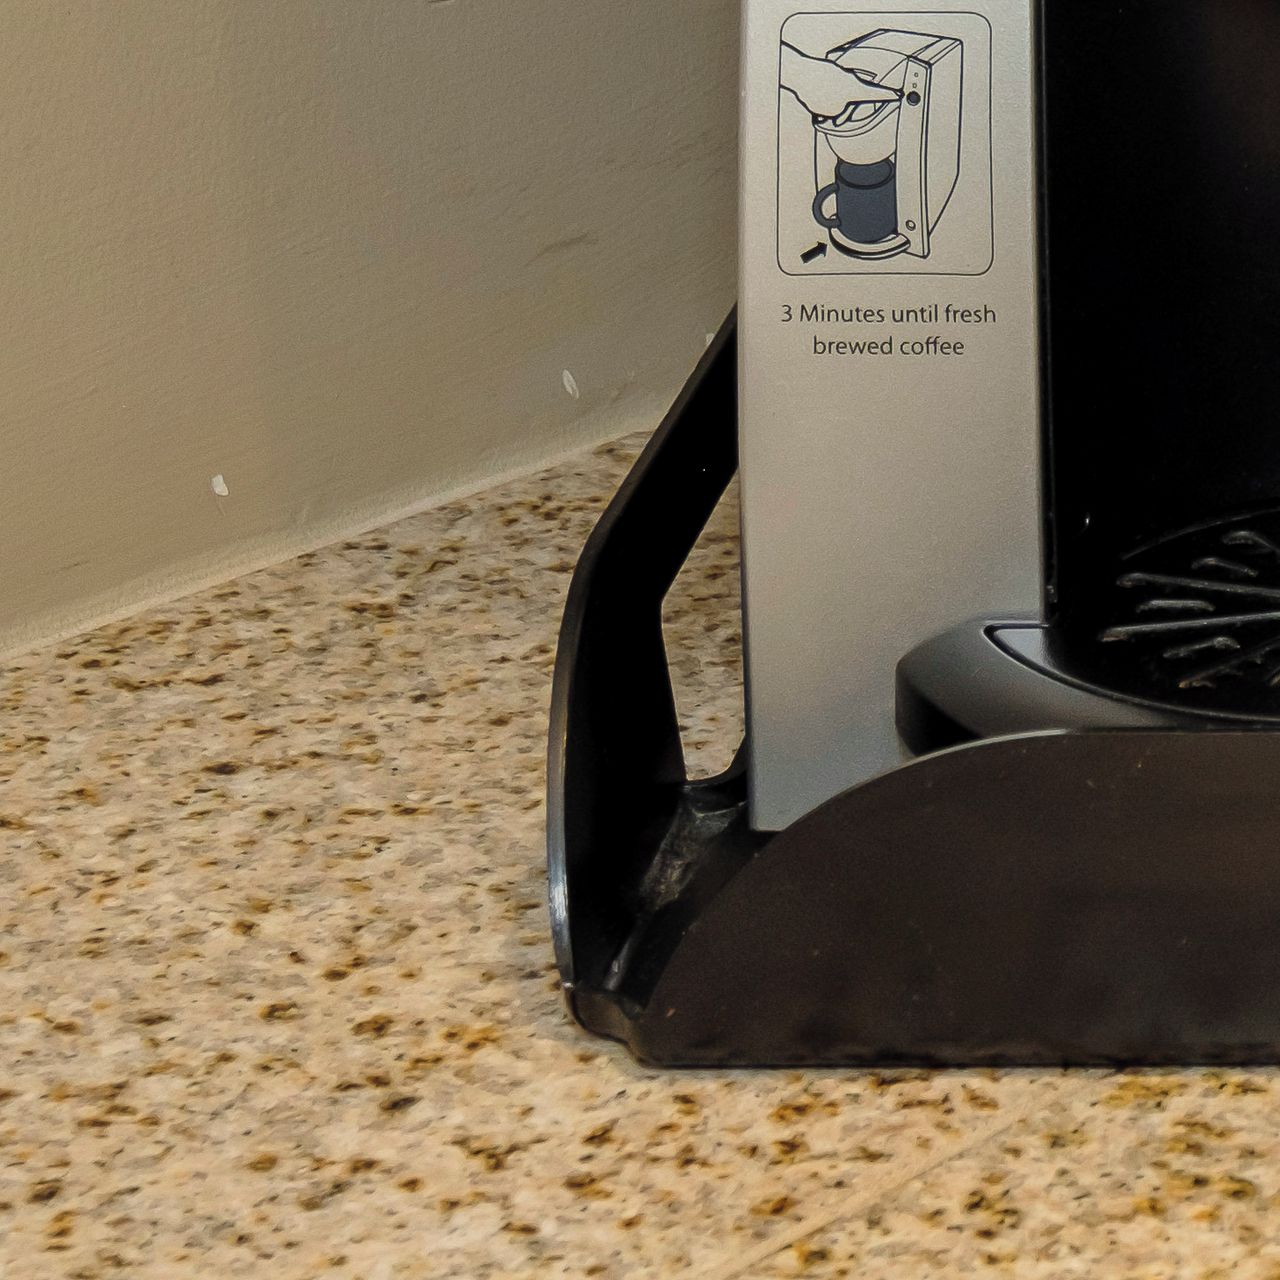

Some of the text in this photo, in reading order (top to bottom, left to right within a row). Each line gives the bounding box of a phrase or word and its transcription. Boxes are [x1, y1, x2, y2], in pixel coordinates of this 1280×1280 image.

[780, 303, 997, 323] 3 Minutes until fresh
[812, 334, 966, 356] brewed coffee
